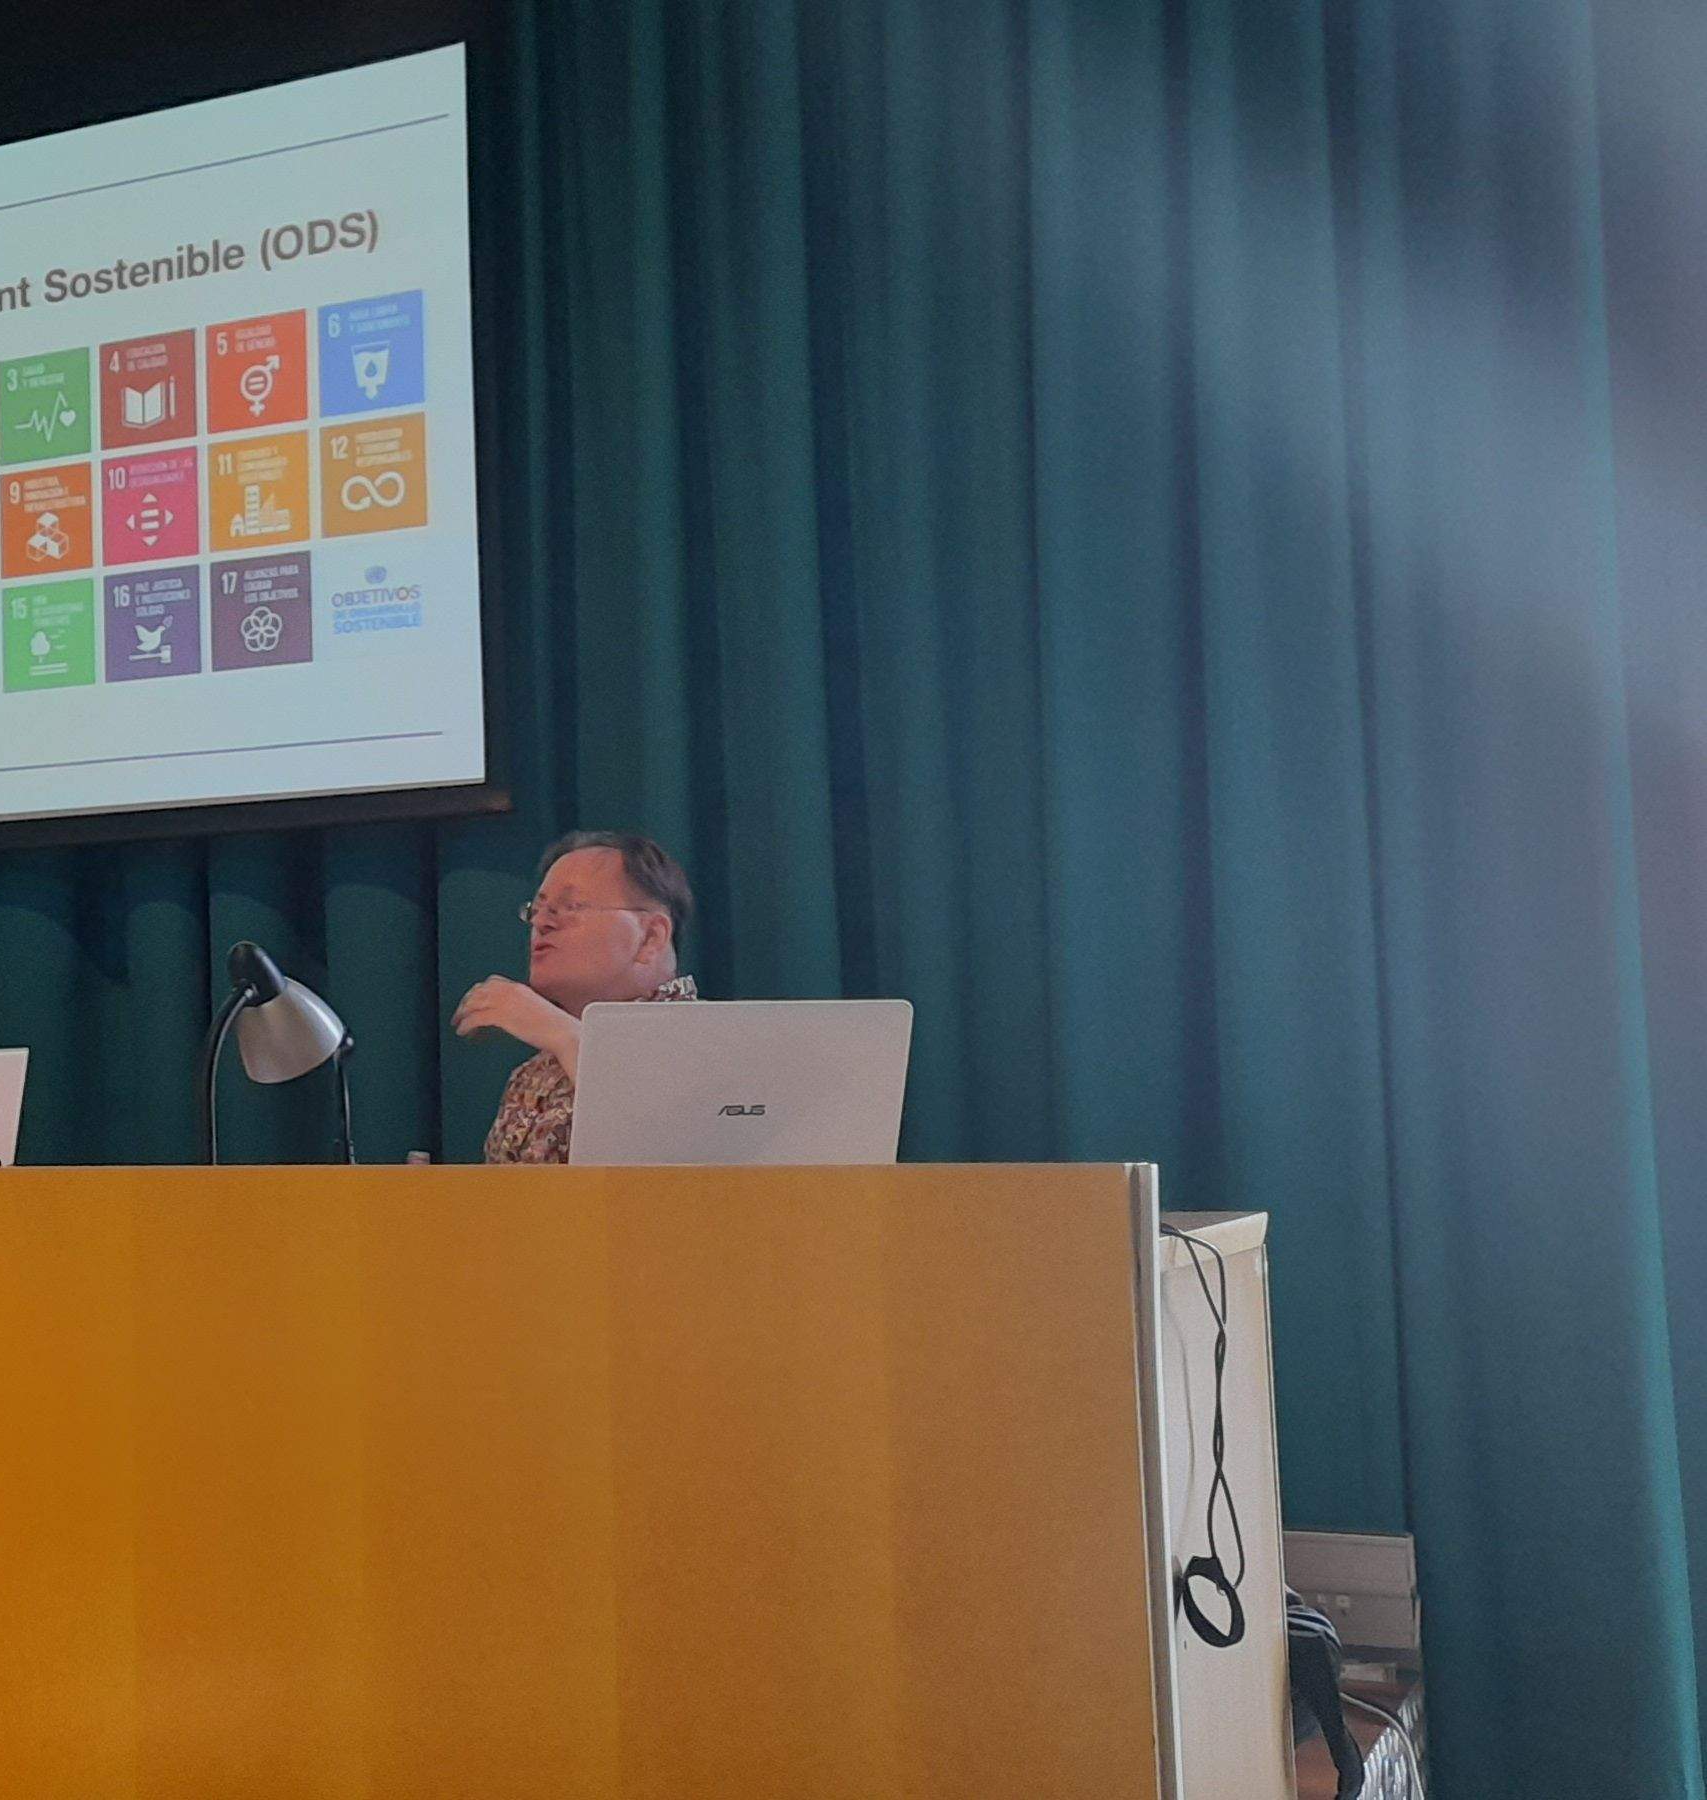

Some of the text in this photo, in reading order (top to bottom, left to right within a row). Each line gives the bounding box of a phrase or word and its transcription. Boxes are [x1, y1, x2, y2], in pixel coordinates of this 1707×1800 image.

[44, 239, 246, 303] Sostenible
[260, 208, 379, 272] (ODS)
[328, 312, 340, 338] 6
[216, 331, 228, 355] 5
[109, 350, 120, 372] 4
[7, 368, 18, 391] 3
[330, 436, 349, 459] 12
[218, 453, 233, 475] 11
[108, 466, 127, 490] 10
[9, 481, 20, 503] 9
[221, 571, 238, 594] 17
[113, 585, 130, 608] 16
[331, 585, 420, 607] OBJETIVOS
[10, 598, 27, 619] 15
[333, 614, 421, 634] SOSTENLE
[717, 1104, 766, 1117] ASUS
